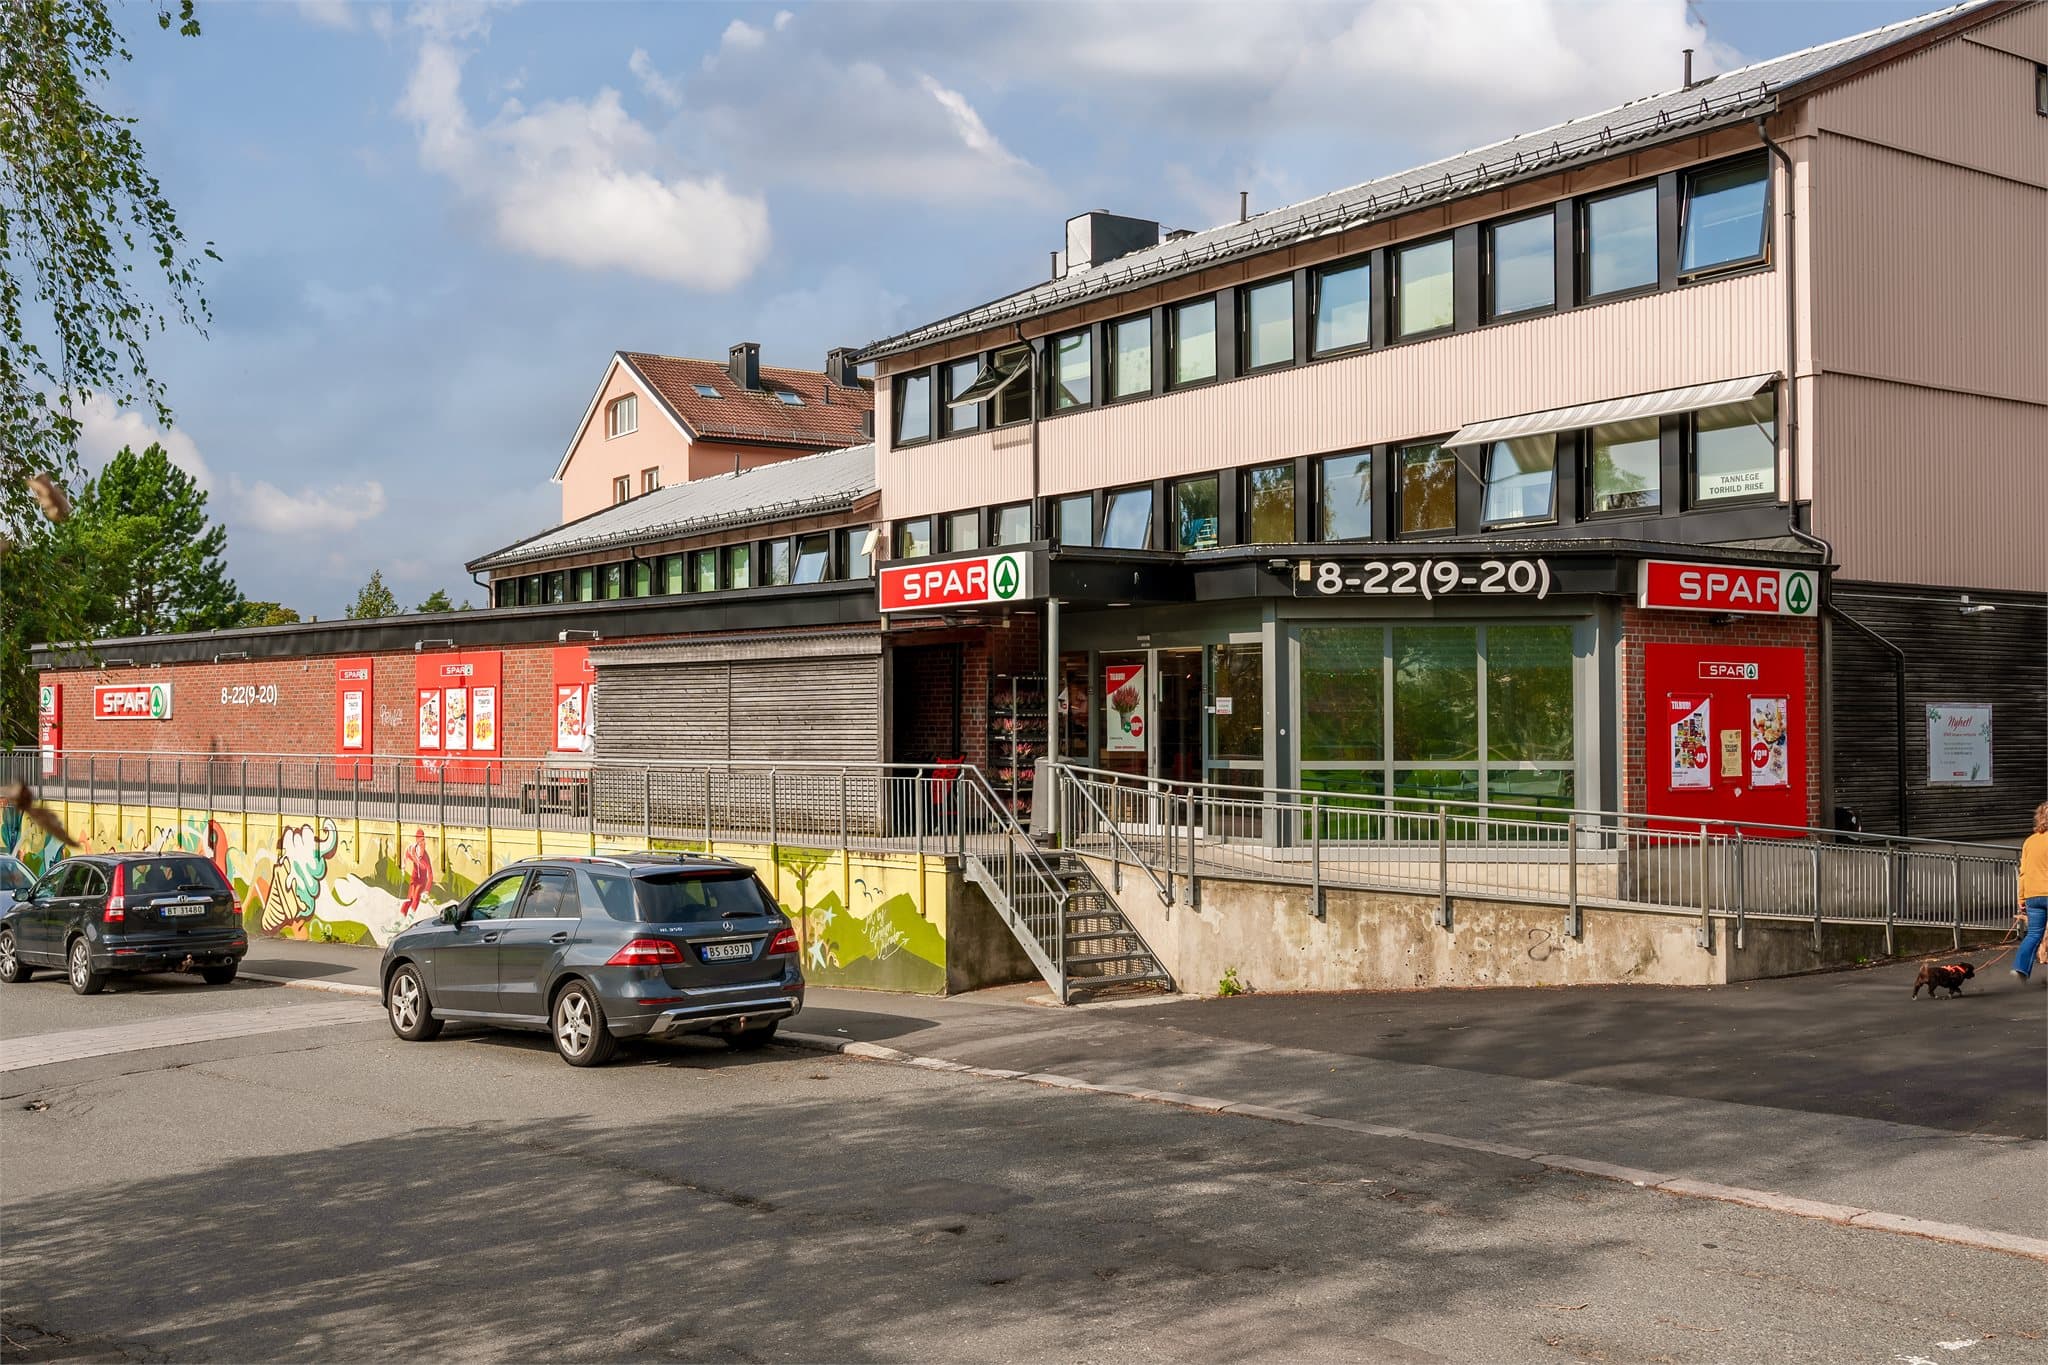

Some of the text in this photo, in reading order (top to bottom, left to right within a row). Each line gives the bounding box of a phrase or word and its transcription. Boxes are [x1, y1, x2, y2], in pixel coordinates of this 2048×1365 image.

[1720, 473, 1760, 483] TANNLEGE
[1709, 485, 1742, 494] TORHILD
[903, 566, 986, 600] SPAR
[1316, 558, 1550, 600] 8-22(9-20)
[1679, 571, 1778, 604] SPAR
[344, 670, 361, 679] SPAR
[446, 666, 465, 674] SPAR
[1709, 664, 1744, 676] SPAR
[103, 691, 149, 713] SPAR
[221, 684, 278, 707] 8-22(9-20)
[167, 905, 177, 915] BT
[709, 943, 750, 957] BS 63970
